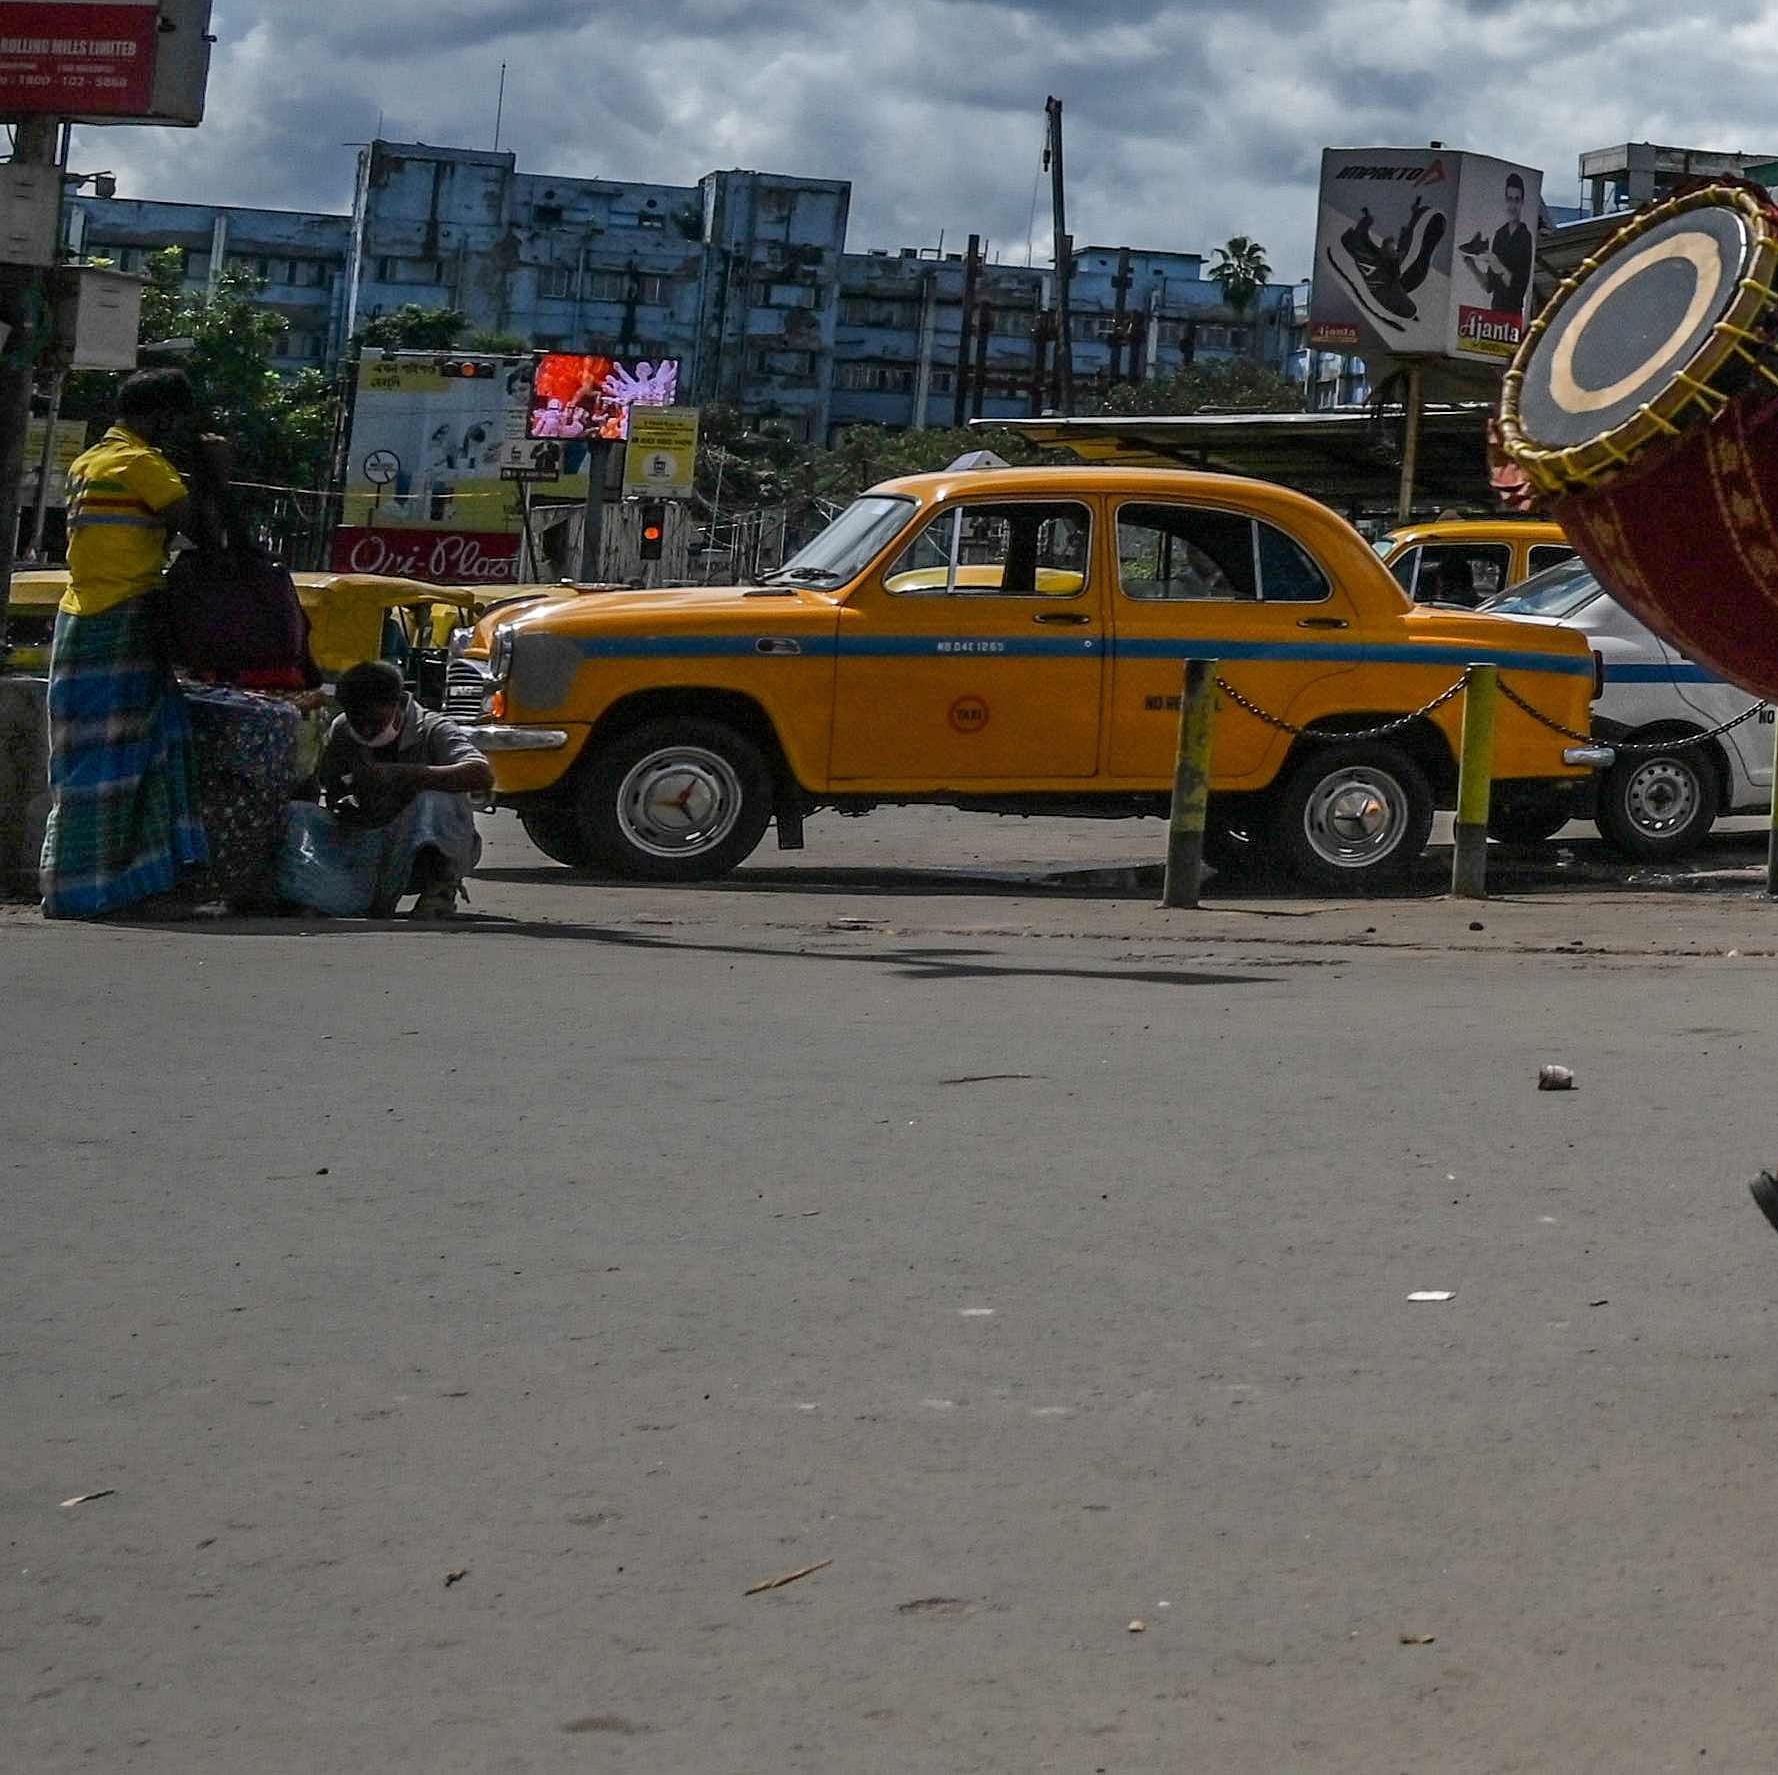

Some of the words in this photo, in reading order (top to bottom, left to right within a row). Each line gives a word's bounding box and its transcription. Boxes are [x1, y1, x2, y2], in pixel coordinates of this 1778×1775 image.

[89, 41, 136, 57] LIMITED
[1459, 313, 1520, 344] Ajanta
[1759, 709, 1775, 724] NO
